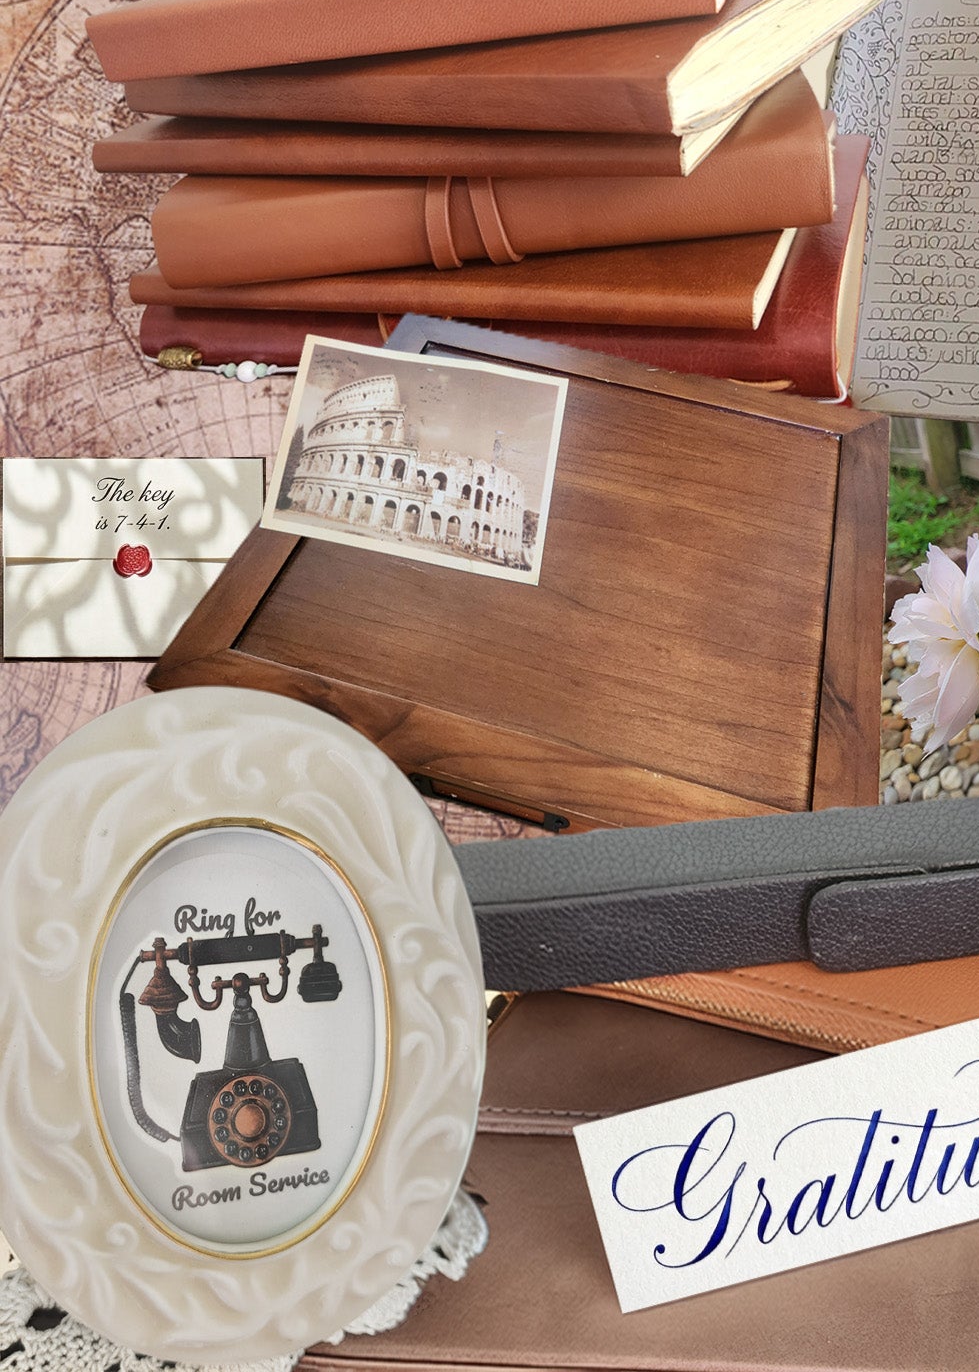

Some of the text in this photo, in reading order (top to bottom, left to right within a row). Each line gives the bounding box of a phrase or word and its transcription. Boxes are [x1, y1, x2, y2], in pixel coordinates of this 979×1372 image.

[92, 477, 176, 511] The key
[95, 513, 170, 533] is 7-4-1.
[174, 897, 281, 939] Ring for
[171, 1167, 330, 1211] Room Service
